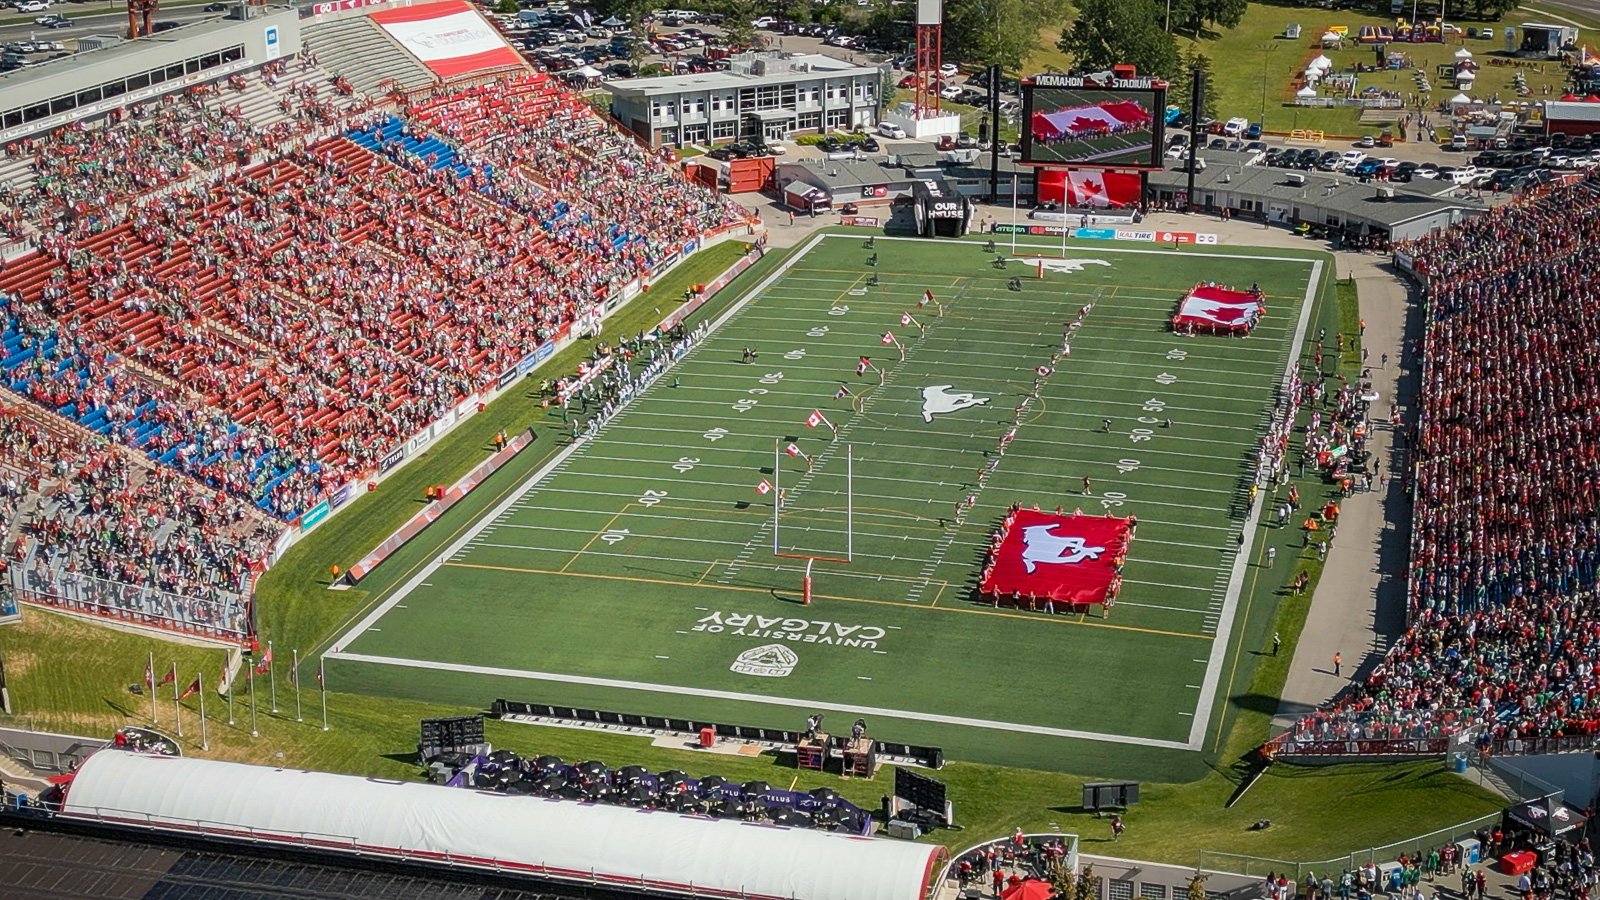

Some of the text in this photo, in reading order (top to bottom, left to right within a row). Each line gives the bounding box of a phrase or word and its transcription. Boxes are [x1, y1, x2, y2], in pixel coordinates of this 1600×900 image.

[320, 4, 332, 13] GO
[1112, 78, 1152, 89] STADIUM
[863, 186, 874, 196] 20
[934, 202, 957, 211] OUR
[1119, 230, 1152, 239] KAL TIRE
[732, 399, 758, 411] 50
[671, 456, 700, 470] 30
[638, 489, 668, 504] 20
[1101, 492, 1127, 507] 30
[601, 529, 629, 541] 10
[697, 611, 886, 640] CALGARY
[691, 623, 878, 649] UNIVERSITY OF
[766, 795, 791, 803] TELUS
